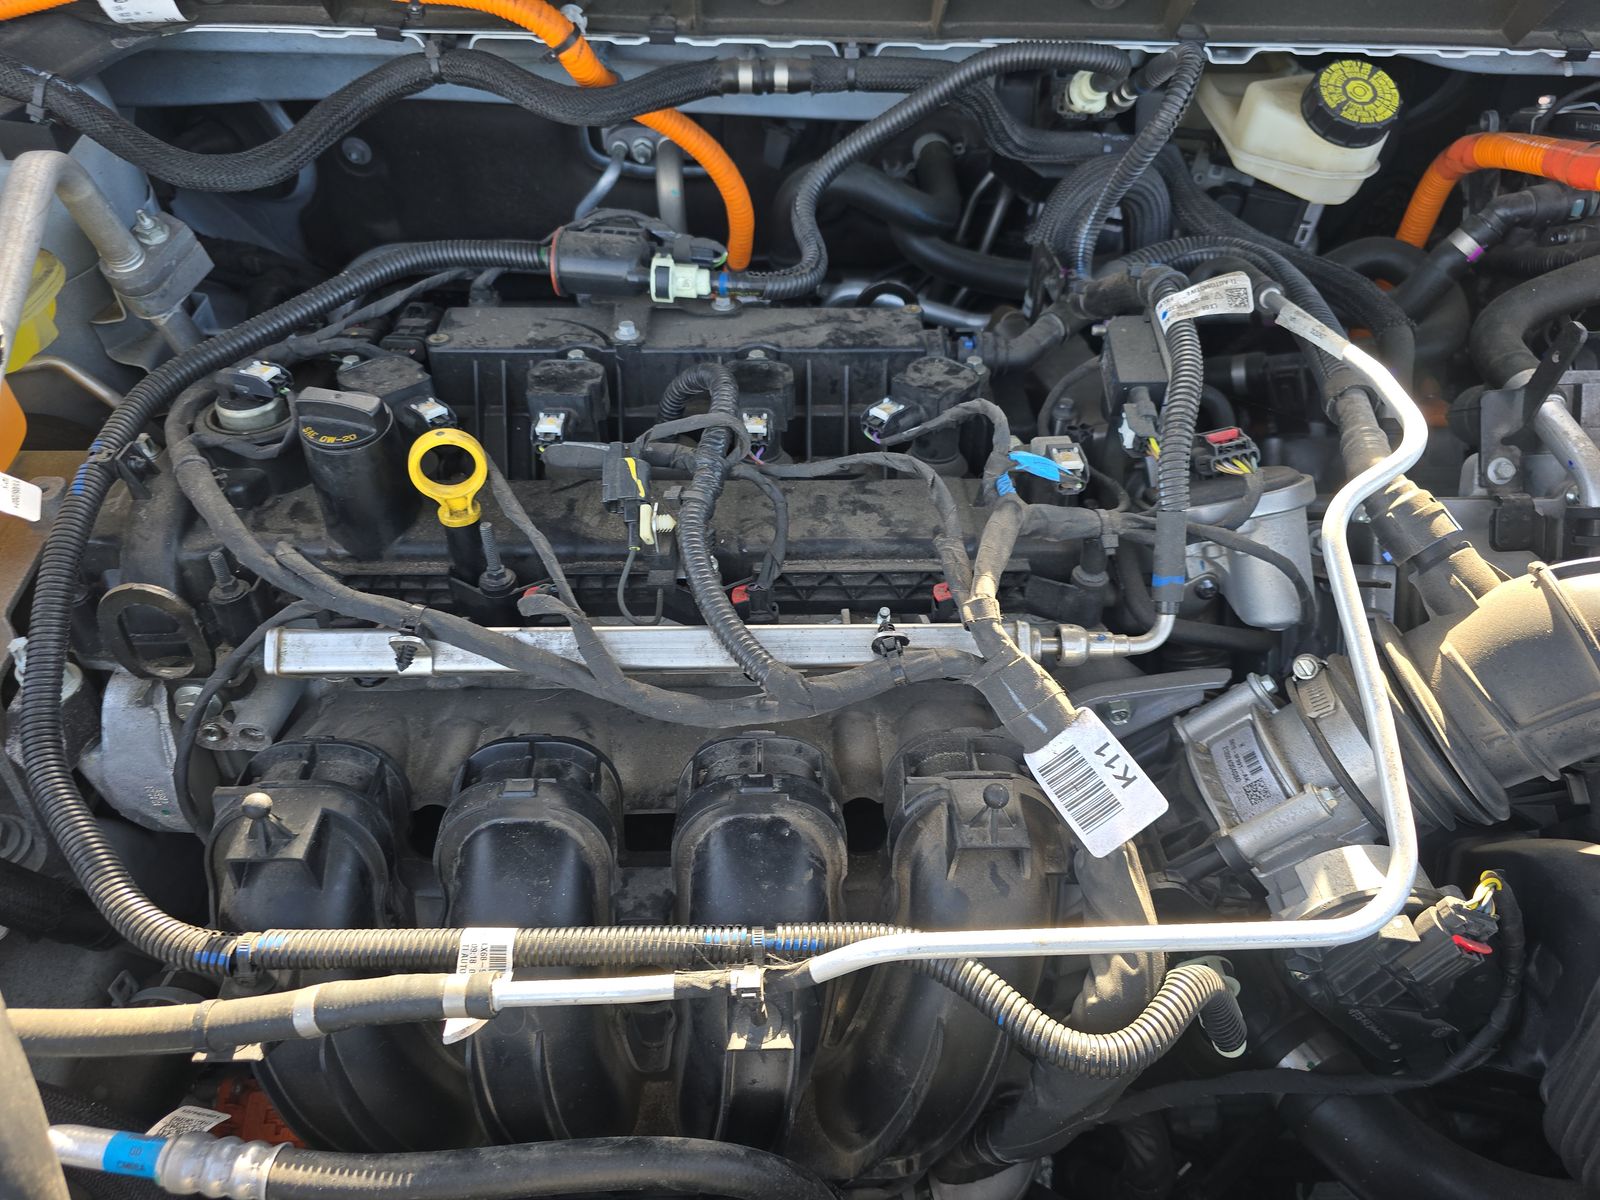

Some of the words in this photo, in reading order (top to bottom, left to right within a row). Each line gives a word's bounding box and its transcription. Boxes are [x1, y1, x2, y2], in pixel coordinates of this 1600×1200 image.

[302, 426, 319, 439] SAE
[319, 433, 358, 444] 0W-20
[1093, 741, 1138, 790] K11
